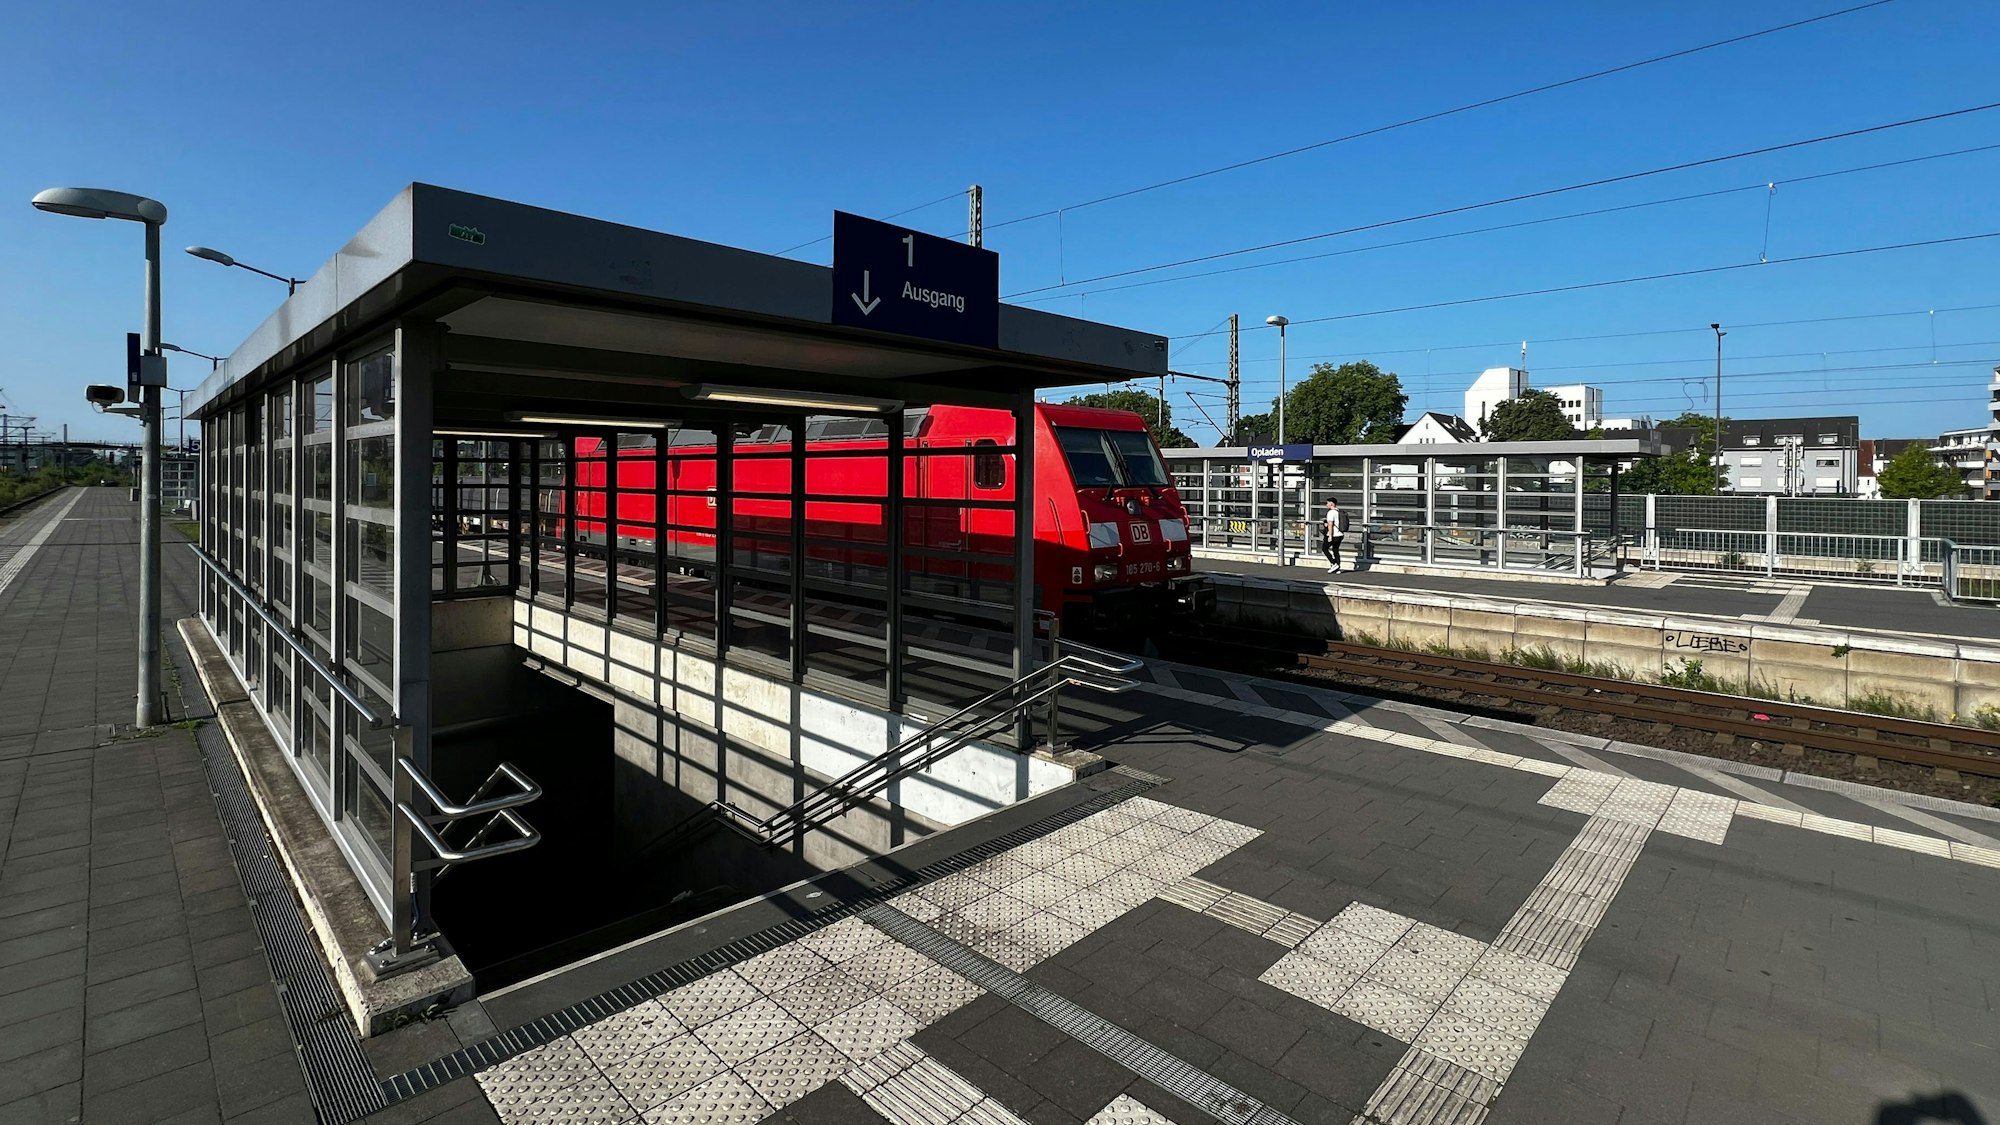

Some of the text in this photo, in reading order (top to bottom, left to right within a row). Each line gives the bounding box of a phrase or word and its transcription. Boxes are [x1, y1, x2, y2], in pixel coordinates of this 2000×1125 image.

[902, 234, 914, 267] 1
[902, 281, 965, 313] Ausgang
[191, 440, 200, 451] 5
[1251, 447, 1284, 458] Opladen
[1132, 524, 1149, 540] DB
[1126, 561, 1161, 575] 185 270-6
